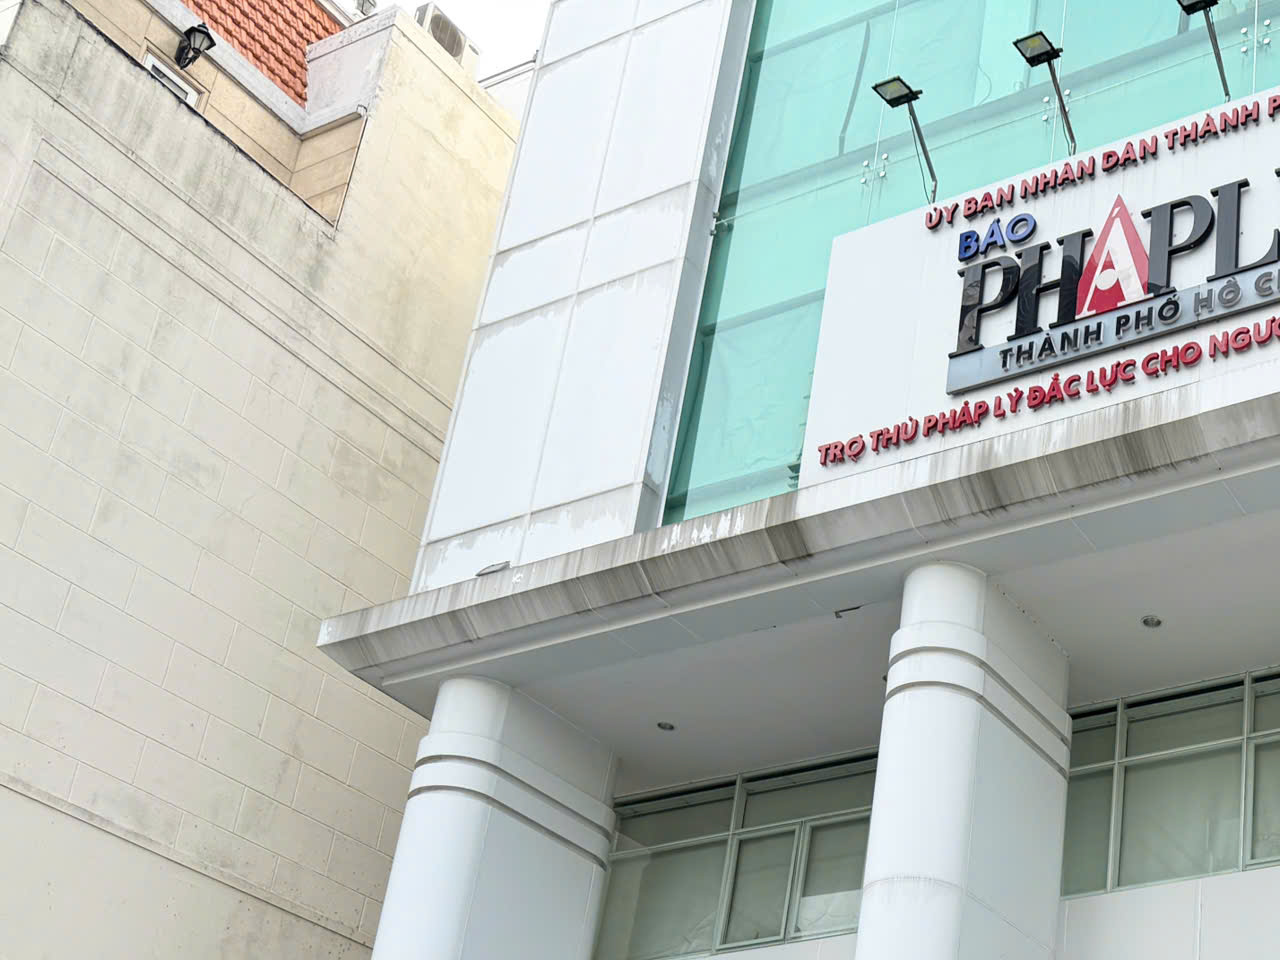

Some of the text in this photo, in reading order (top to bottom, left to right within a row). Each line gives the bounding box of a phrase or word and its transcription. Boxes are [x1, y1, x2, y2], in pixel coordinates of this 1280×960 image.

[925, 203, 958, 231] ỦY
[963, 184, 1015, 219] BAN
[1020, 156, 1095, 199] NHÂN
[1101, 136, 1158, 173] DÂN
[1165, 101, 1258, 150] THÀNH
[958, 212, 1037, 262] BÁO
[999, 316, 1104, 370] THÀNH
[1115, 296, 1181, 339] PHỐ
[1193, 275, 1242, 313] HỒ
[818, 434, 865, 467] TRỢ
[869, 415, 916, 452] THỦ
[922, 400, 989, 438] PHÁP
[994, 387, 1023, 418] LÝ
[1027, 373, 1081, 410] ĐẮC
[1086, 357, 1137, 393] LỰC
[1141, 340, 1201, 379] CHO
